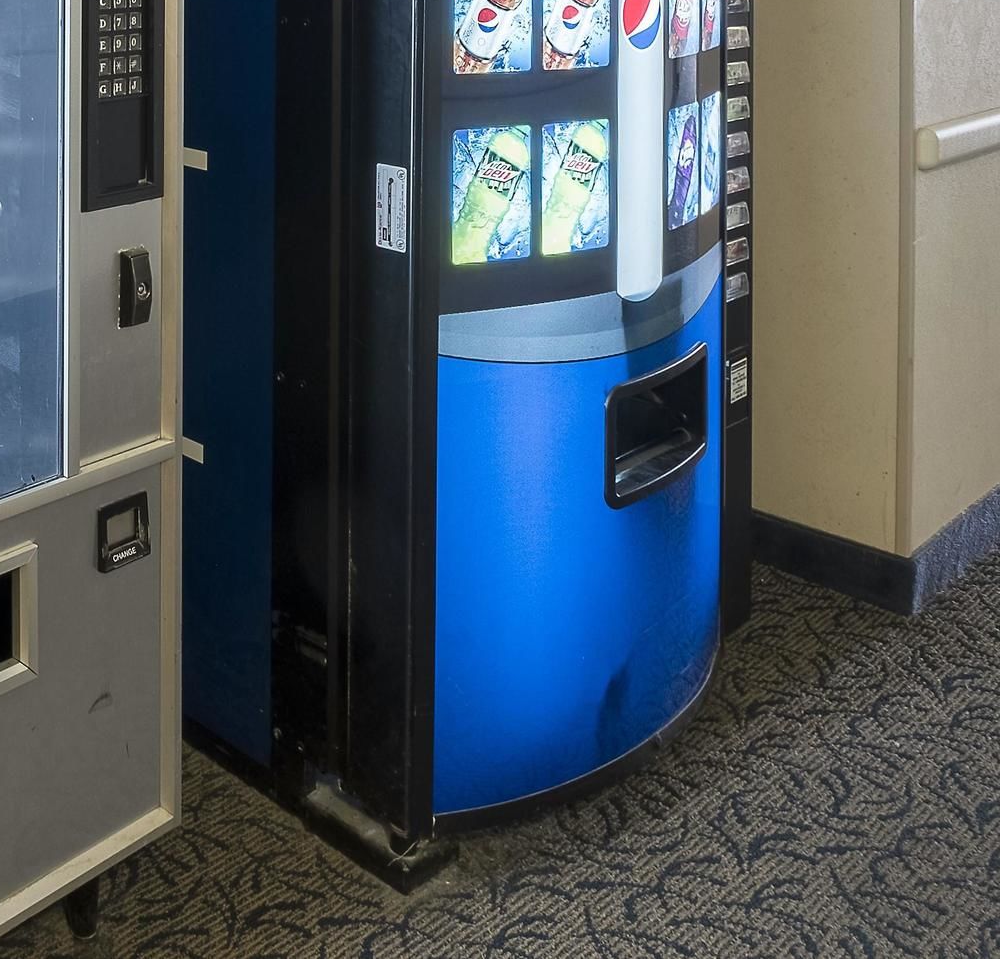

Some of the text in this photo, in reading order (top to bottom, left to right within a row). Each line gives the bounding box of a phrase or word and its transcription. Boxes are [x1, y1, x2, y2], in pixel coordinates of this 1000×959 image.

[100, 19, 107, 28] D
[100, 41, 107, 50] E
[100, 63, 107, 72] F
[100, 85, 107, 94] G
[112, 546, 137, 563] CHANGE
